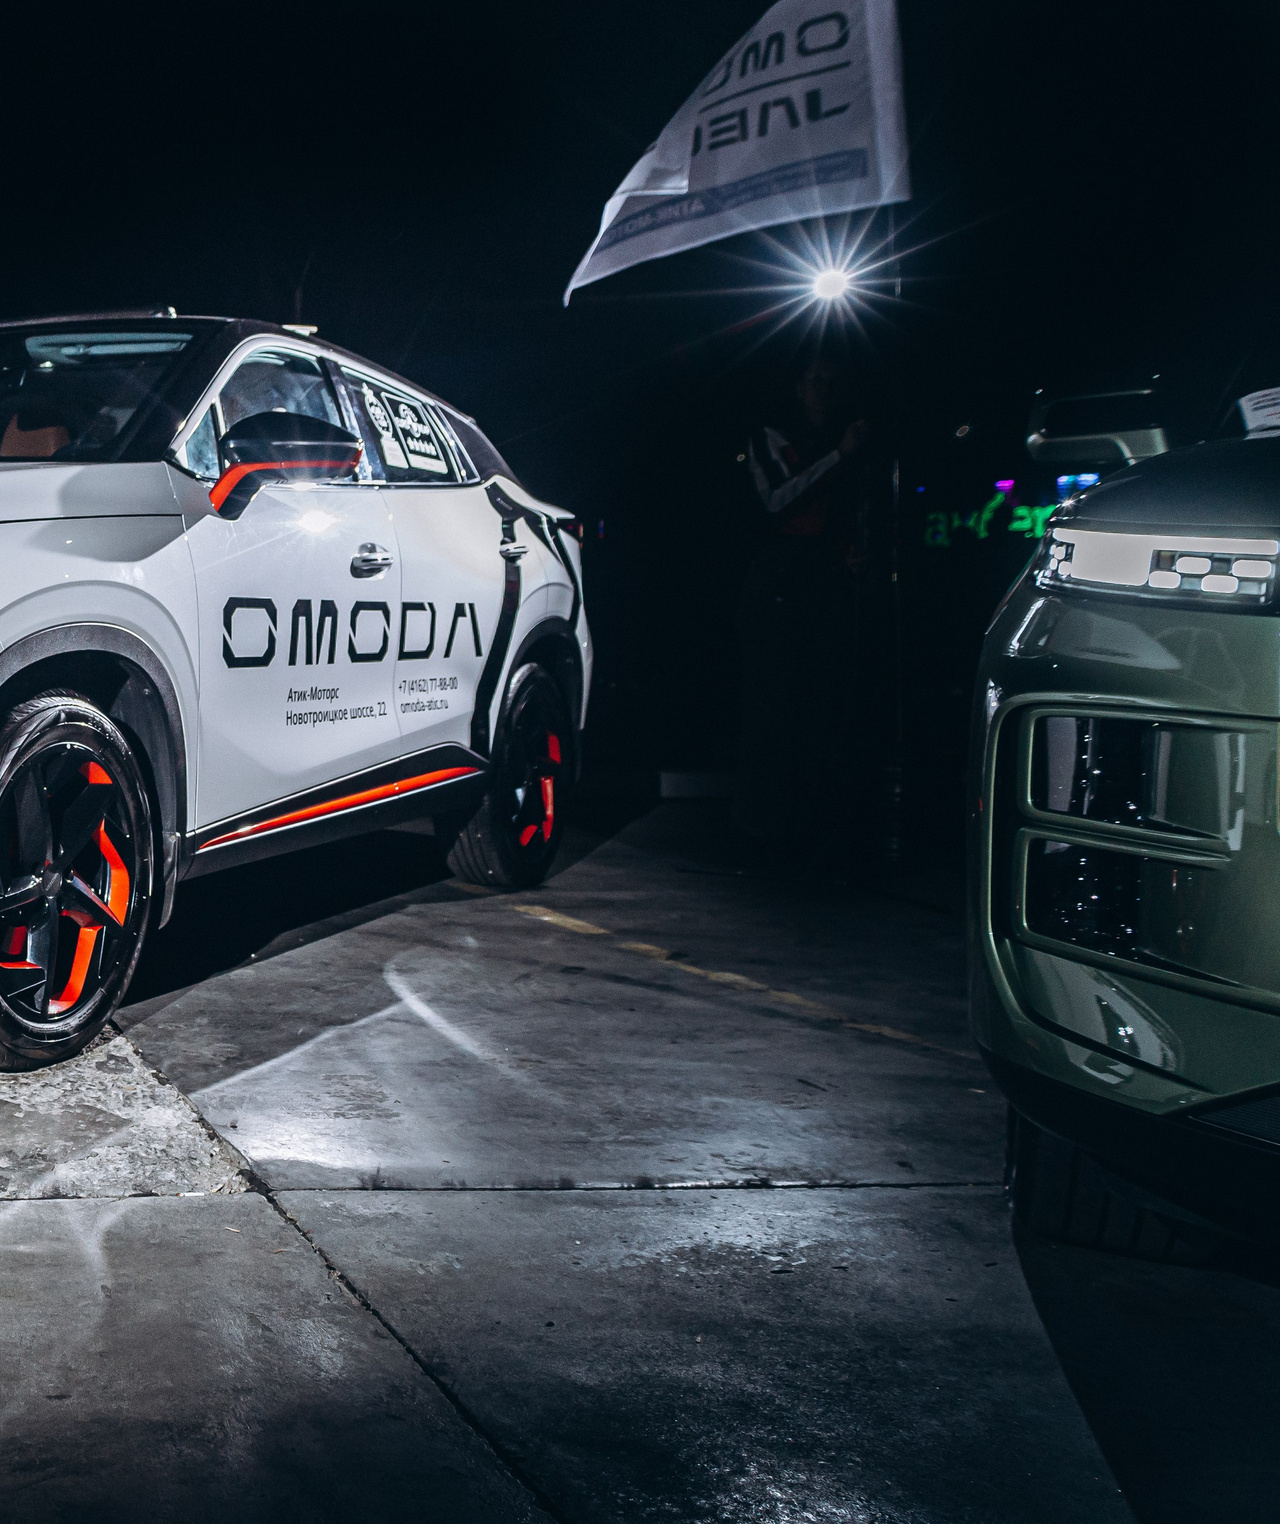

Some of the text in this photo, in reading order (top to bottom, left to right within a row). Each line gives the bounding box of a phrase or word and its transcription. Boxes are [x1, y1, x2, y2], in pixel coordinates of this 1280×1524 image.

[222, 596, 483, 669] OMODA
[287, 686, 340, 703] Атик-Моторс
[286, 701, 387, 728] Новотроицкое шоссе, 22
